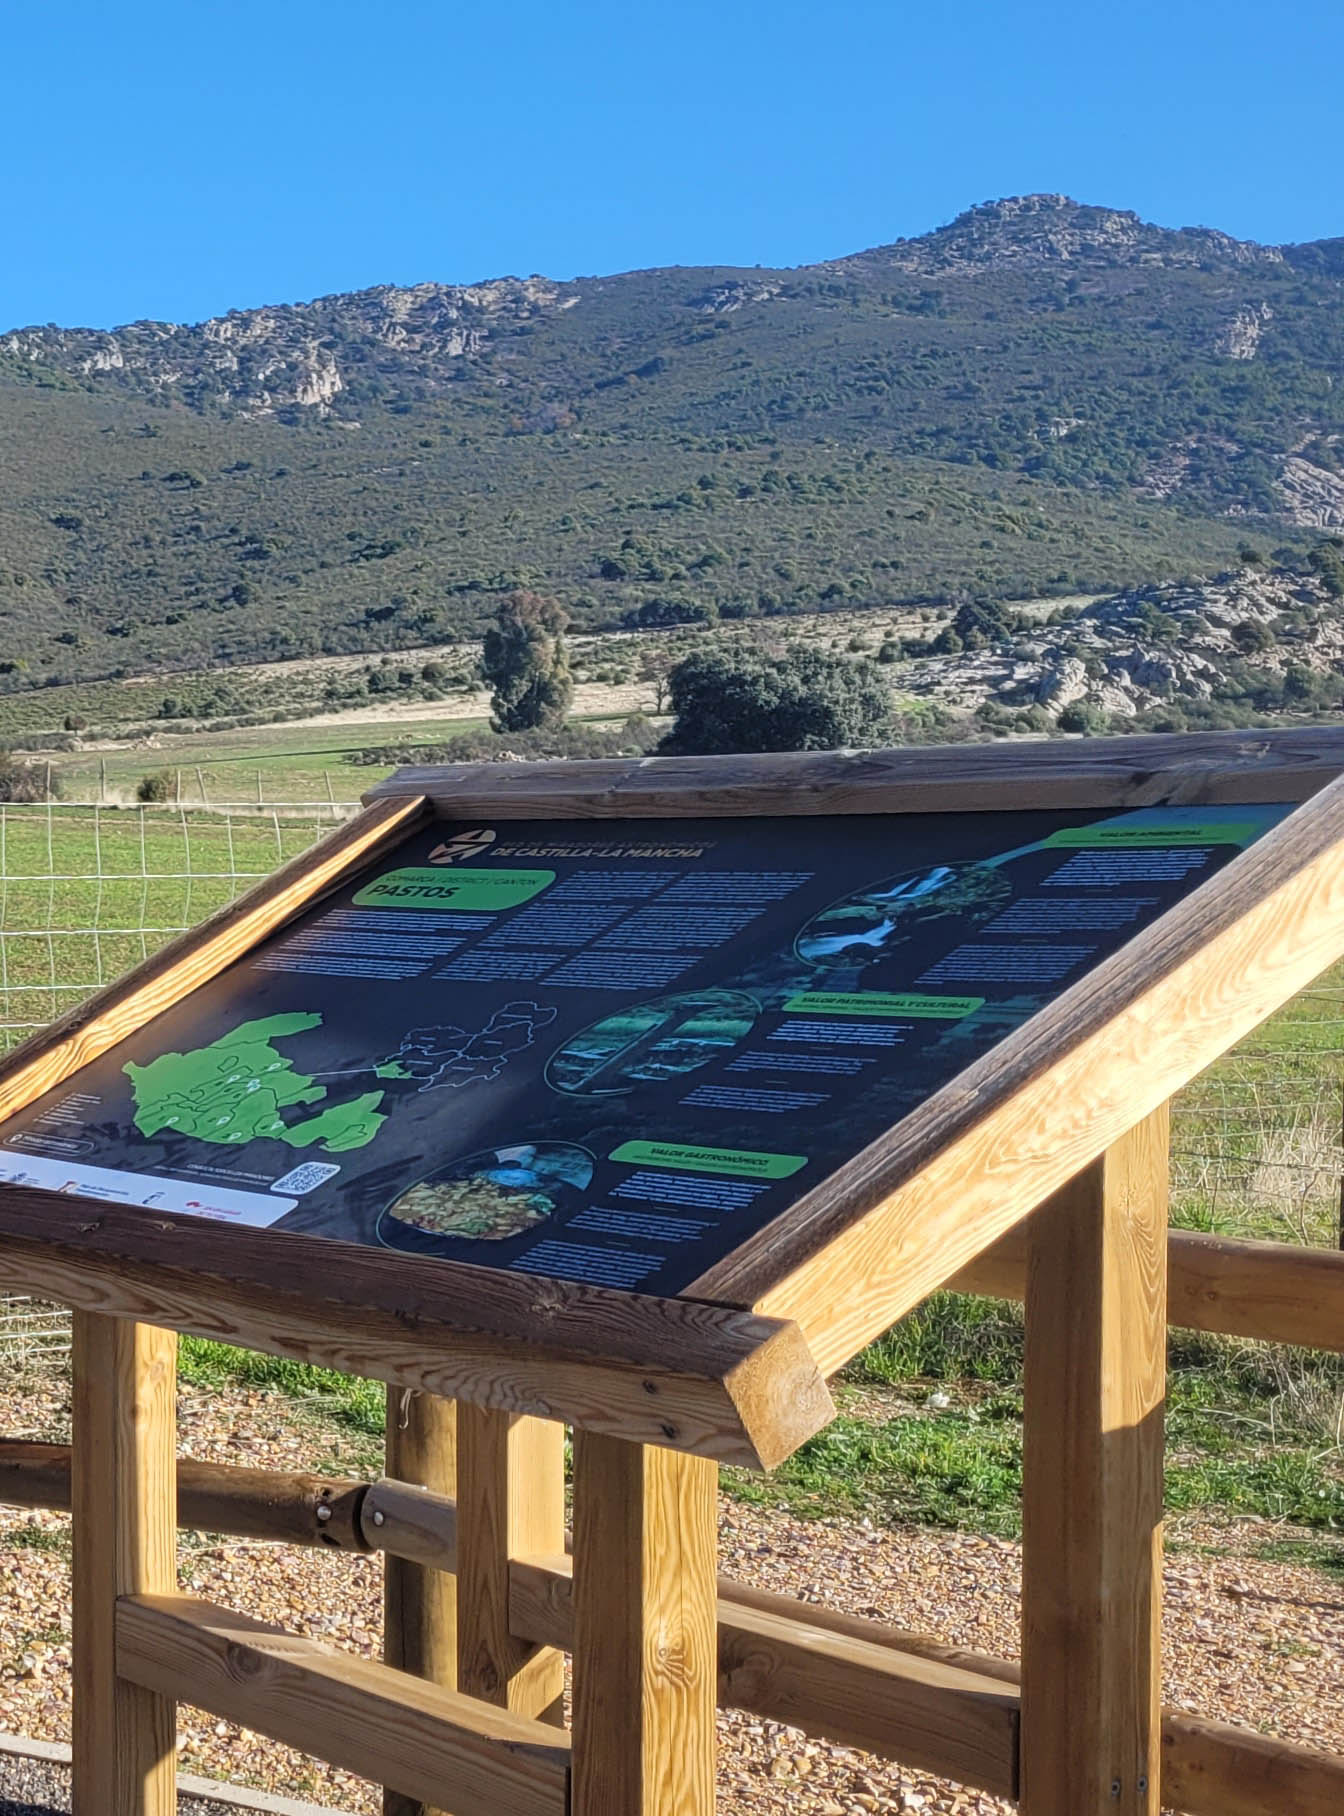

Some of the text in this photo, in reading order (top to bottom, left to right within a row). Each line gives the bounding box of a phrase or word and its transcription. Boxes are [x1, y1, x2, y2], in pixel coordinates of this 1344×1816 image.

[490, 848, 704, 858] DE CASTILLA-LA MANCHA
[366, 885, 460, 899] PASTOS
[651, 1148, 684, 1156] VALOR
